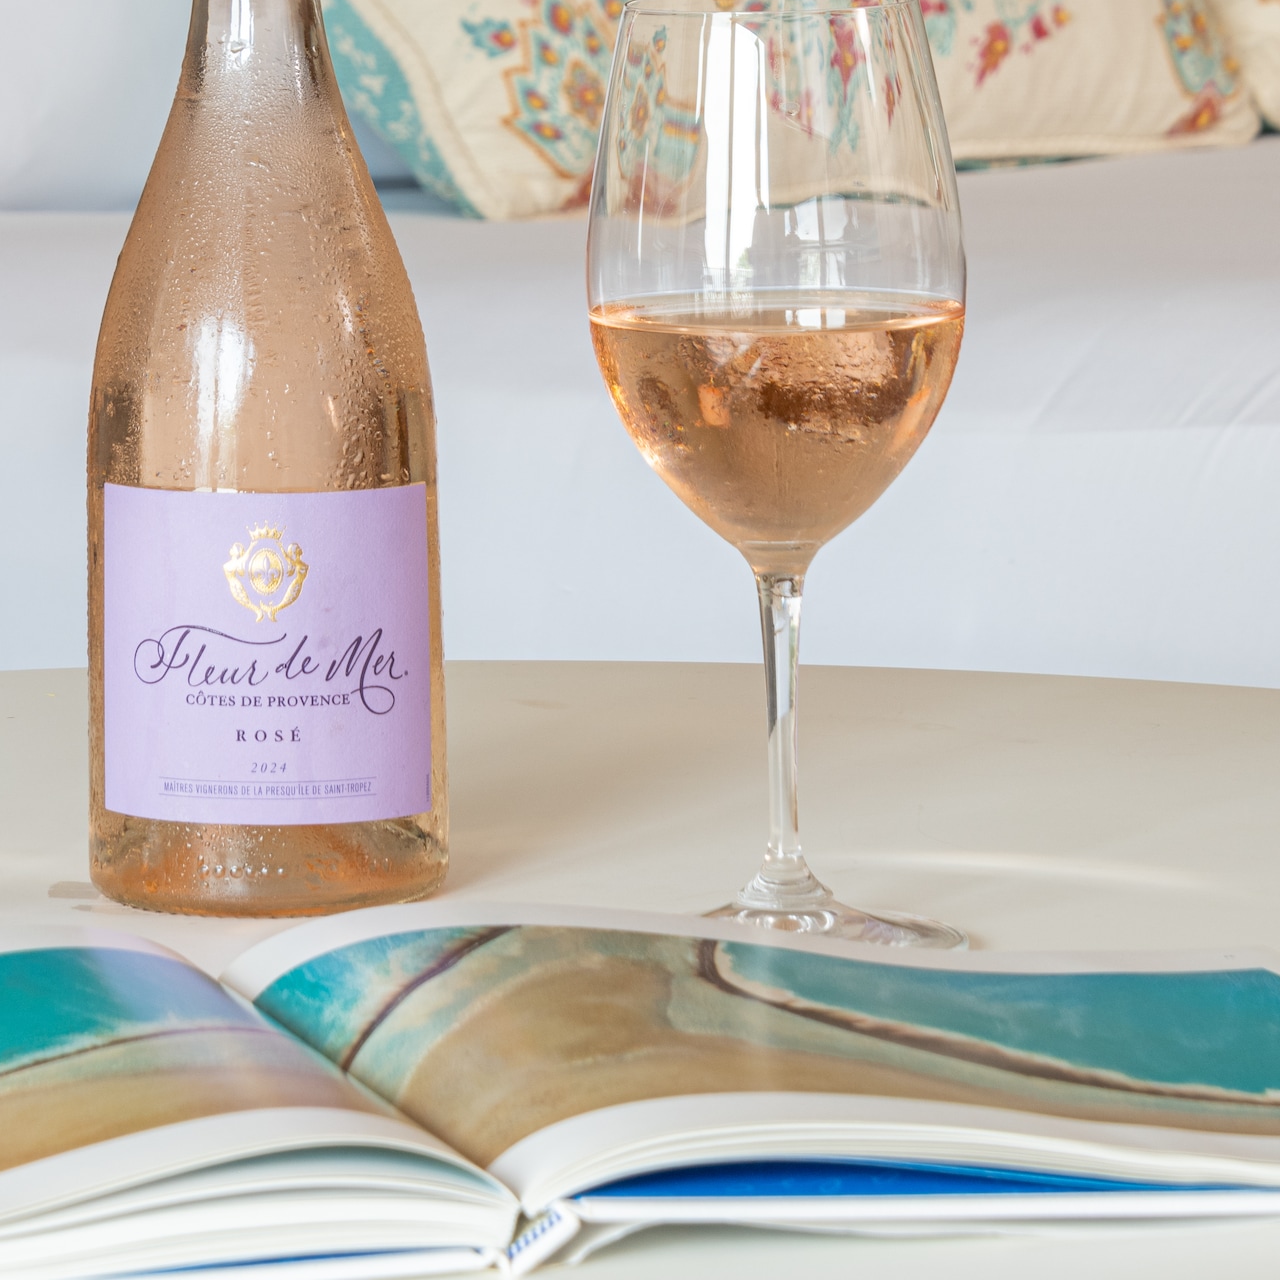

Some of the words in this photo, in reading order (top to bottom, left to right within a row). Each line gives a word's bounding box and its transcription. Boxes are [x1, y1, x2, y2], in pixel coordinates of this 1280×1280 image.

[133, 624, 287, 687] Fleur
[275, 634, 320, 680] de
[185, 690, 236, 707] CÔTES
[241, 695, 263, 707] DE
[268, 693, 351, 707] PROVENCE
[235, 726, 302, 743] ROSÉ
[250, 762, 288, 774] 2024
[195, 783, 239, 796] VIGNERONS
[241, 785, 251, 796] DE
[253, 785, 263, 796] LA
[312, 784, 321, 795] DE
[324, 781, 373, 795] SAINT-TROPEZ
